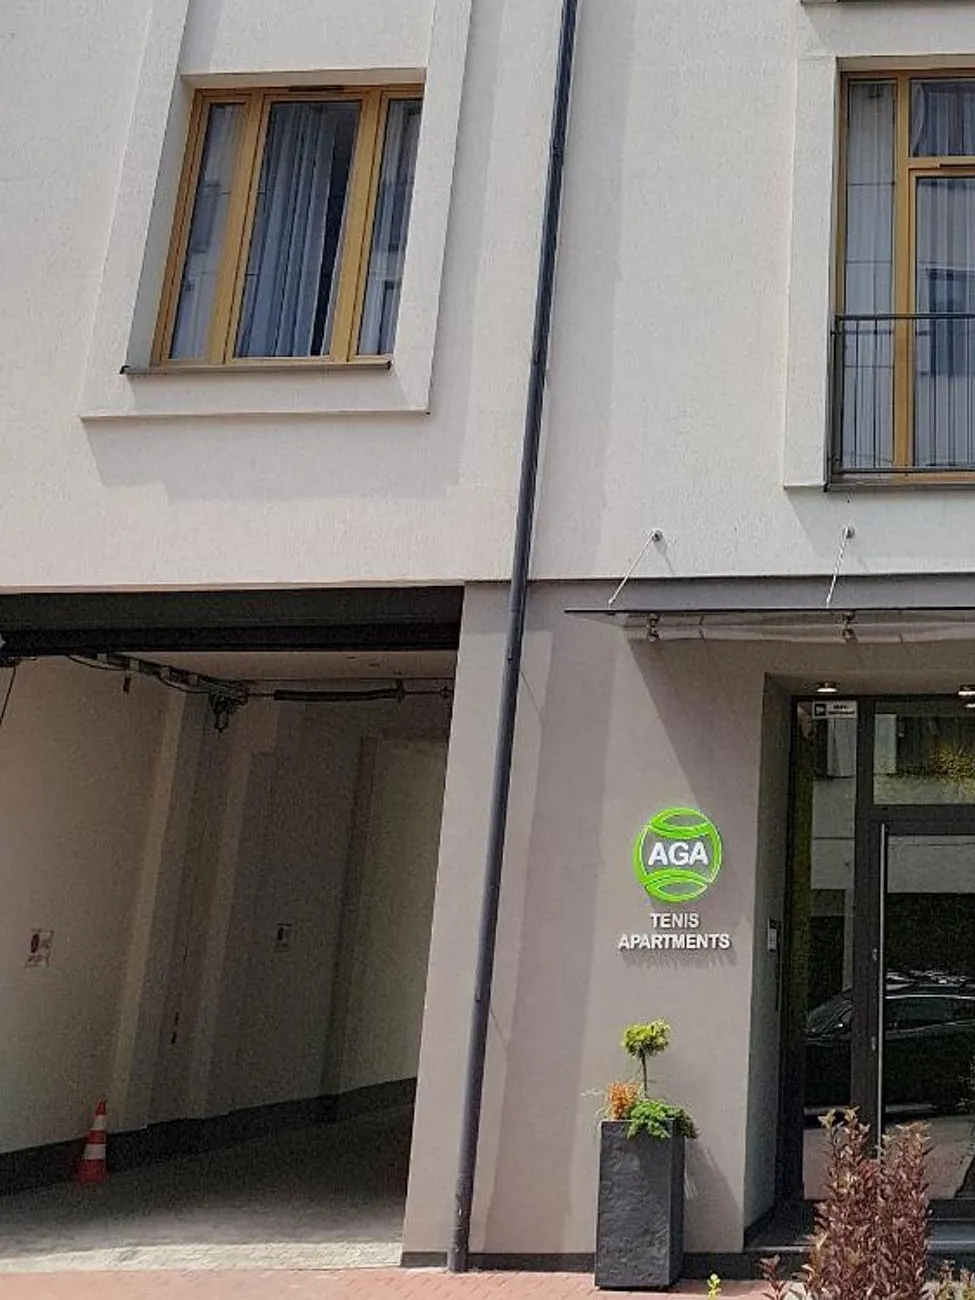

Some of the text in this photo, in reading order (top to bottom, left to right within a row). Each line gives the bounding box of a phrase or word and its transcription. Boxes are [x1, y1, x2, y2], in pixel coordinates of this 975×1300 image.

[647, 841, 709, 866] AGA
[650, 912, 700, 929] TENIS
[618, 933, 731, 950] APARTMENTS
